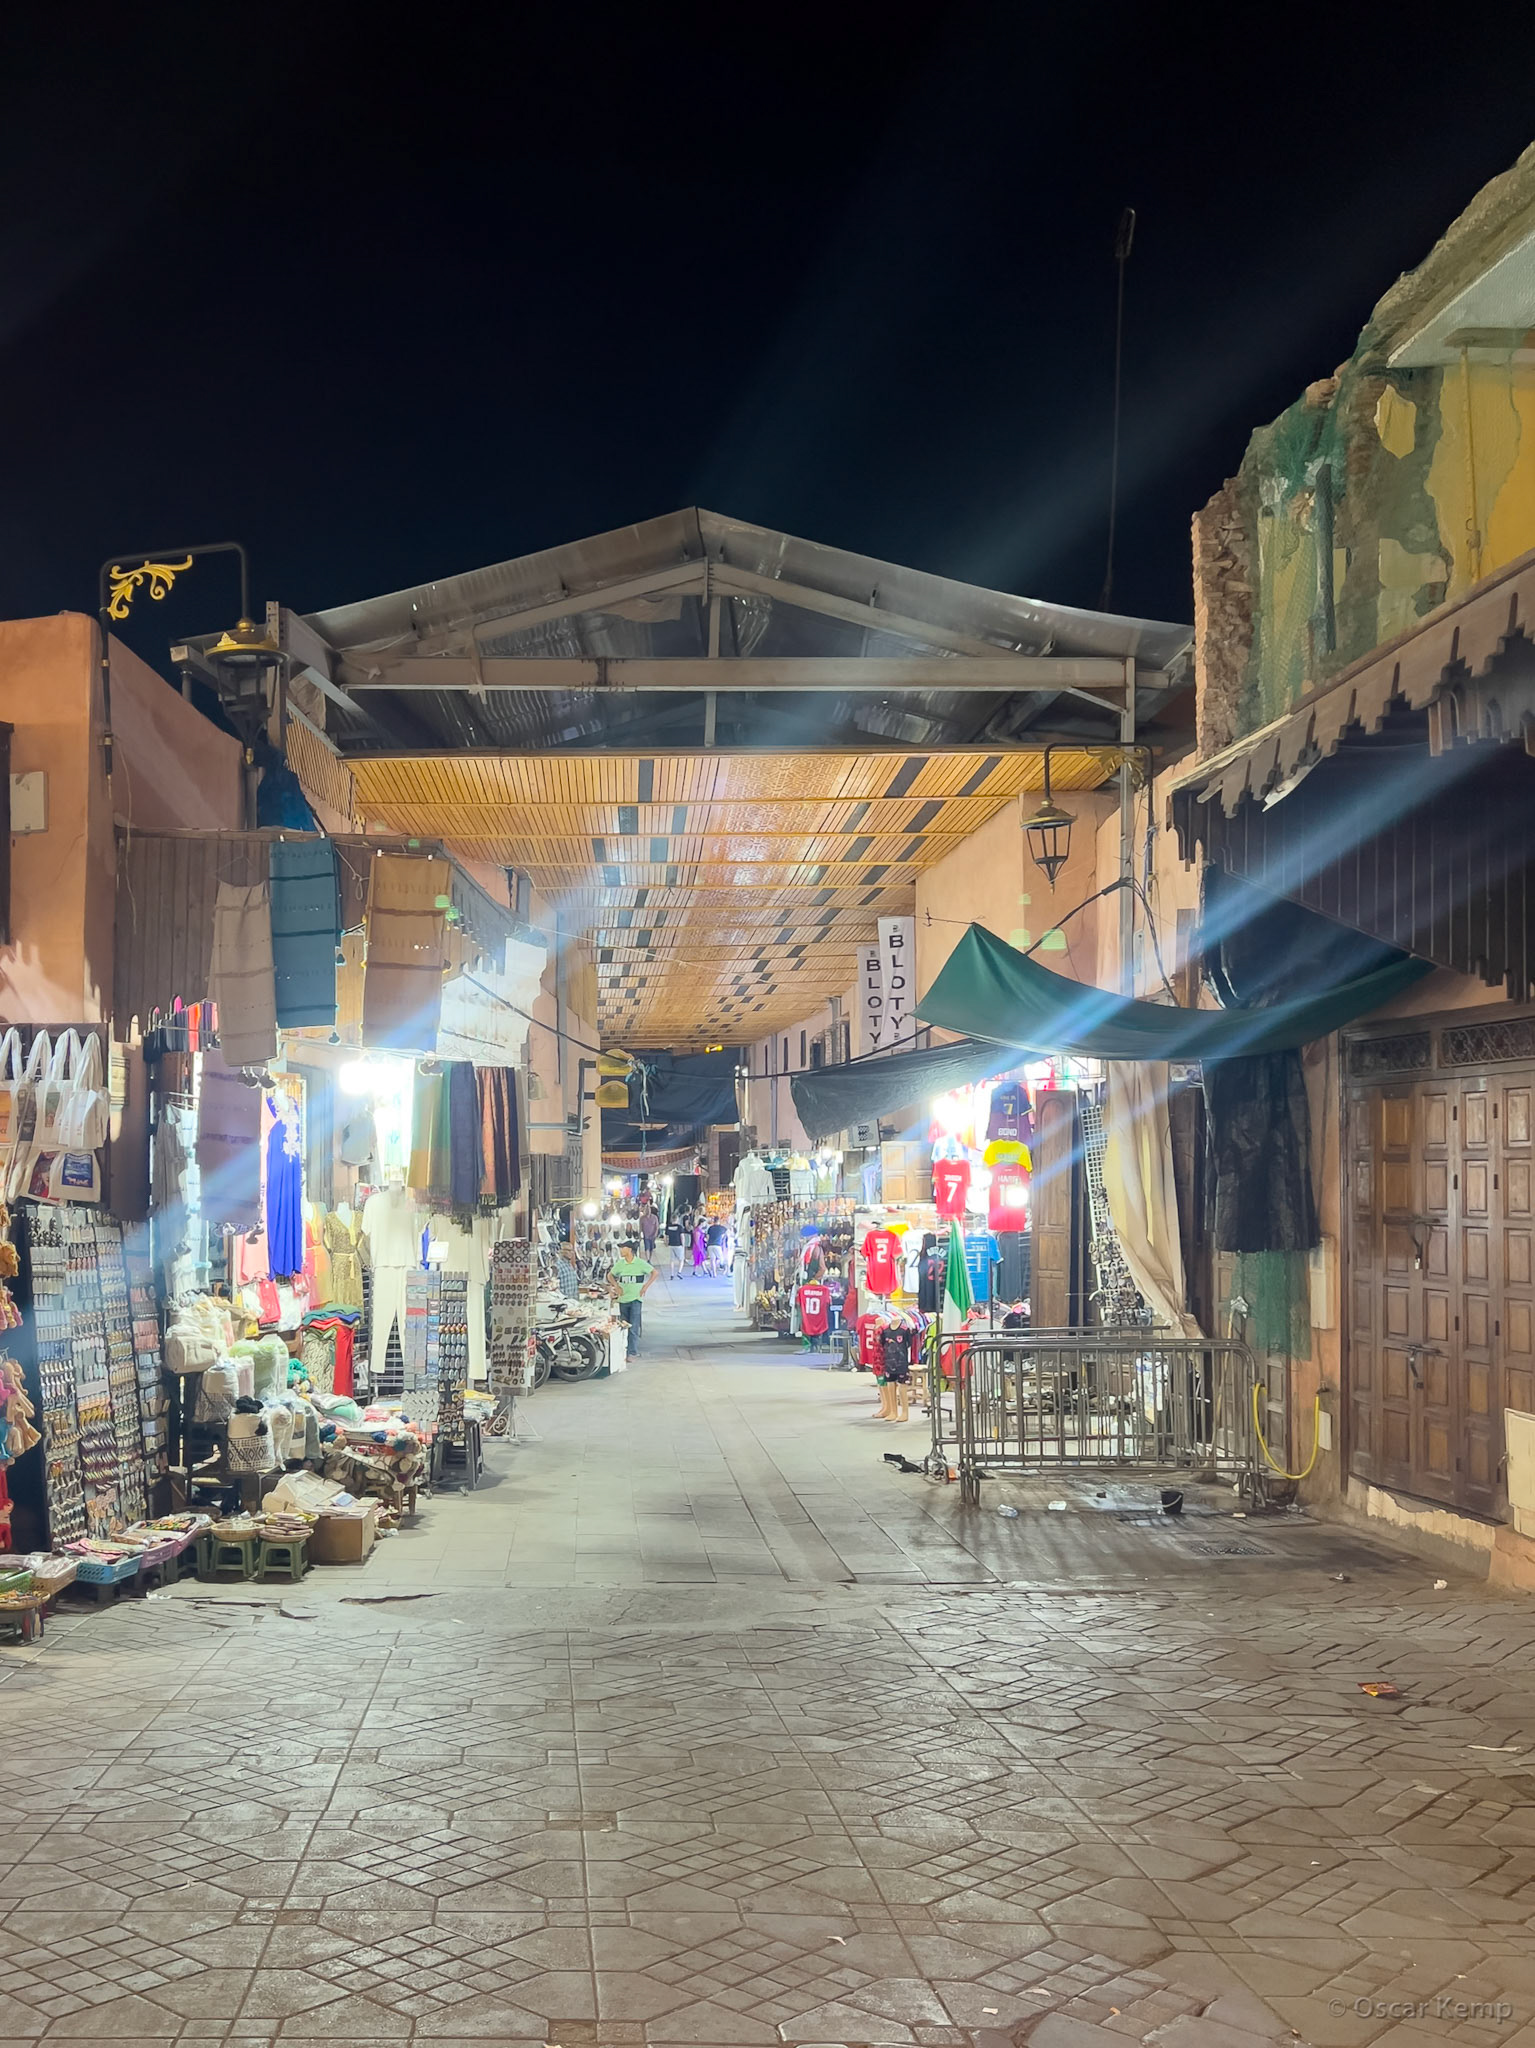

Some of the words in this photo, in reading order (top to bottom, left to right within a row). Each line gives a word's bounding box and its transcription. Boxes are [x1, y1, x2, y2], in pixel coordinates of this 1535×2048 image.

[889, 935, 906, 1030] BLOTY
[866, 959, 882, 1044] BLOTY
[1003, 1103, 1013, 1115] 7
[946, 1182, 958, 1203] 7
[877, 1244, 888, 1263] 2
[805, 1297, 820, 1315] 10
[866, 1330, 874, 1350] 2
